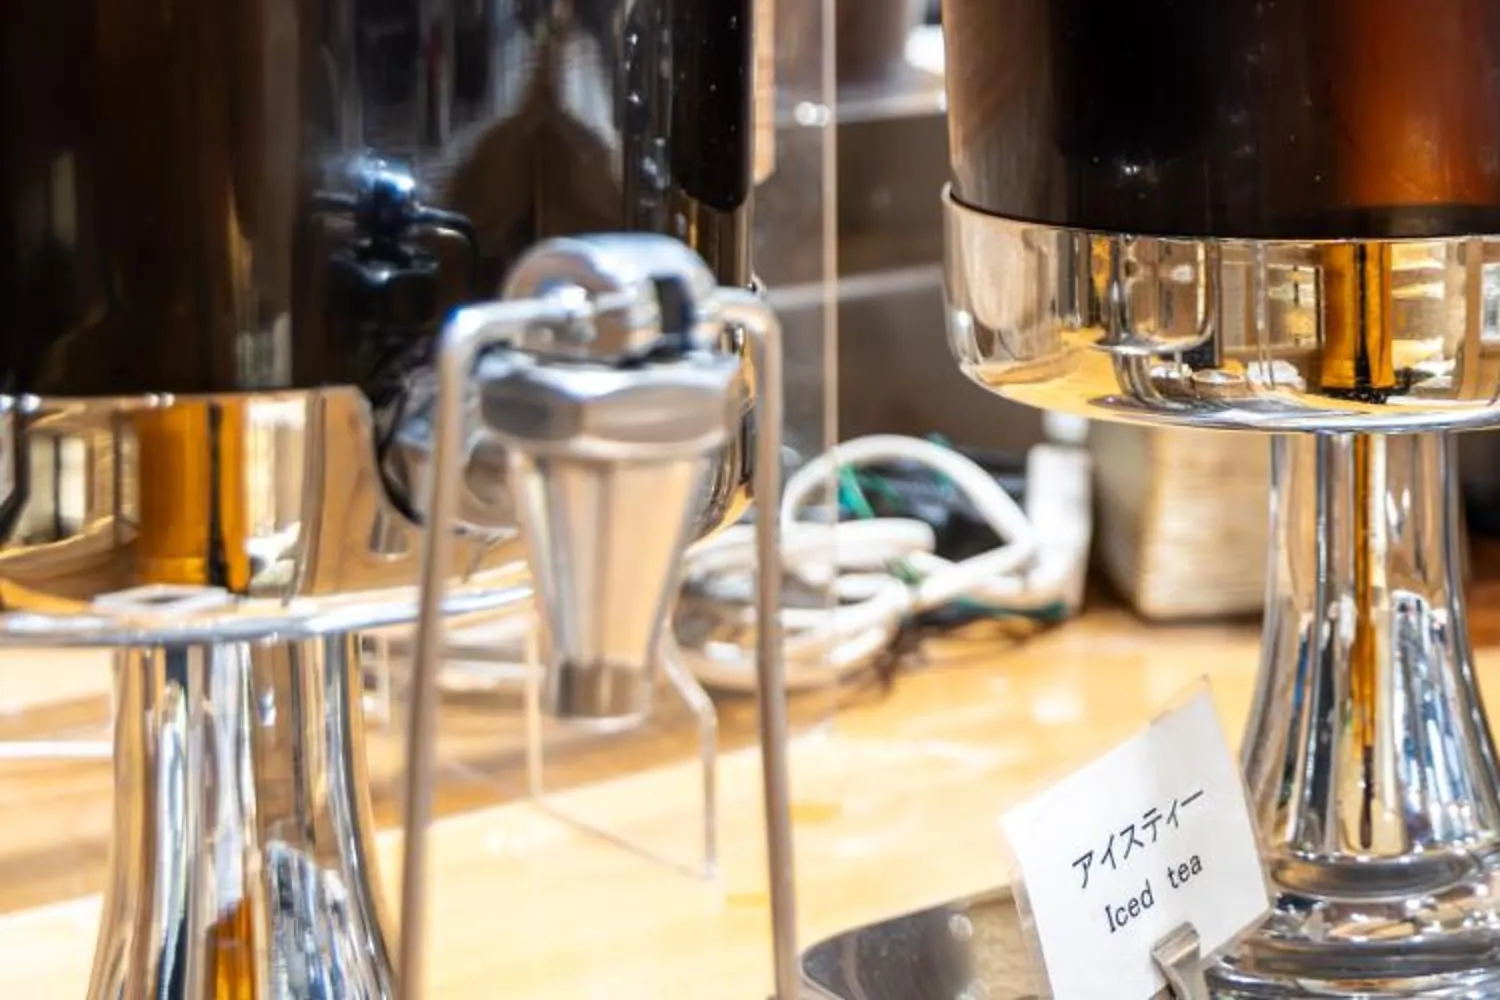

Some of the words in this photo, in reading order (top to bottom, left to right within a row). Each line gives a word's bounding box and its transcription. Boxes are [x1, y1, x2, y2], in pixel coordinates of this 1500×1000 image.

[1071, 789, 1205, 889] アイスティー
[1104, 879, 1155, 933] Iced
[1167, 854, 1203, 888] tea
